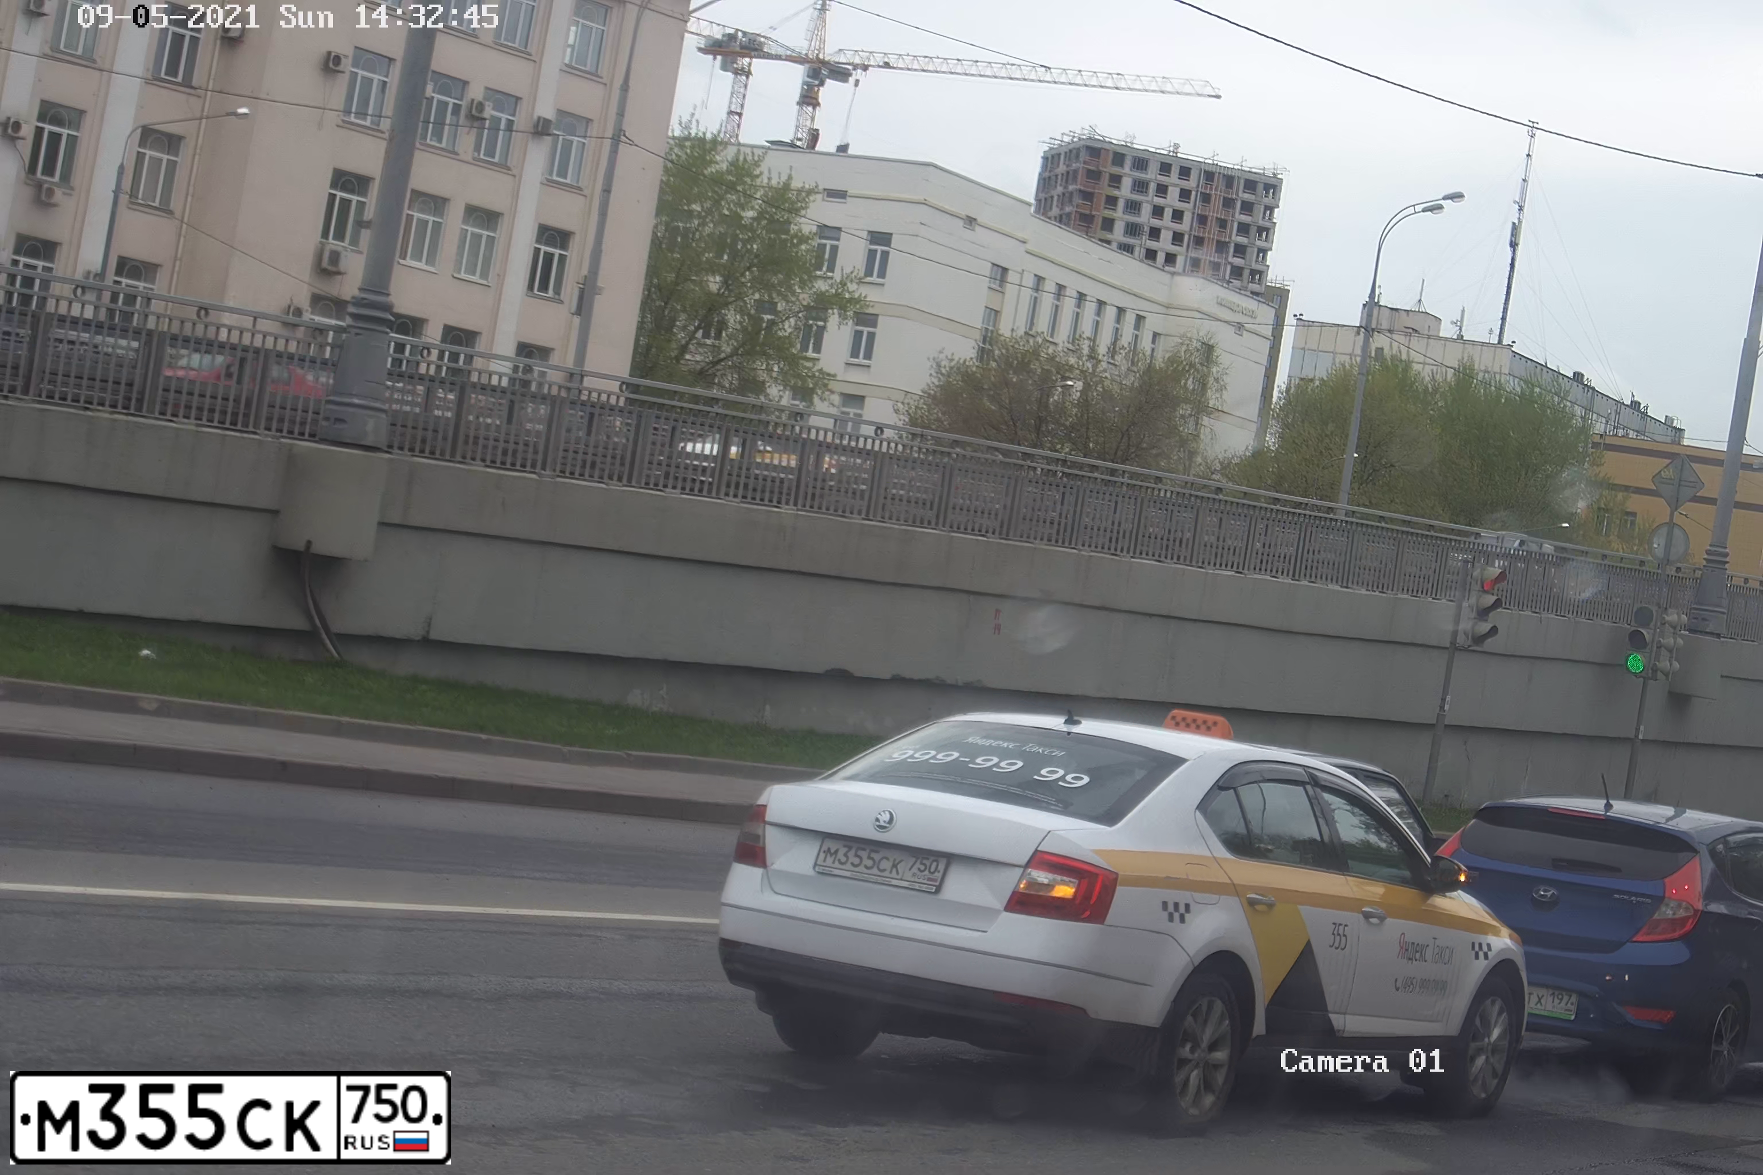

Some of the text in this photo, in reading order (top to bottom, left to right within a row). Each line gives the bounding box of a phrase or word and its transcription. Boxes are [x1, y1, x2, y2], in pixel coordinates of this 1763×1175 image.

[962, 736, 1022, 750] Яндекс
[1033, 767, 1091, 788] 99
[908, 856, 940, 875] 750
[1329, 922, 1349, 950] 355
[1397, 932, 1455, 966] Яндекс Такси
[1550, 991, 1573, 1006] 197
